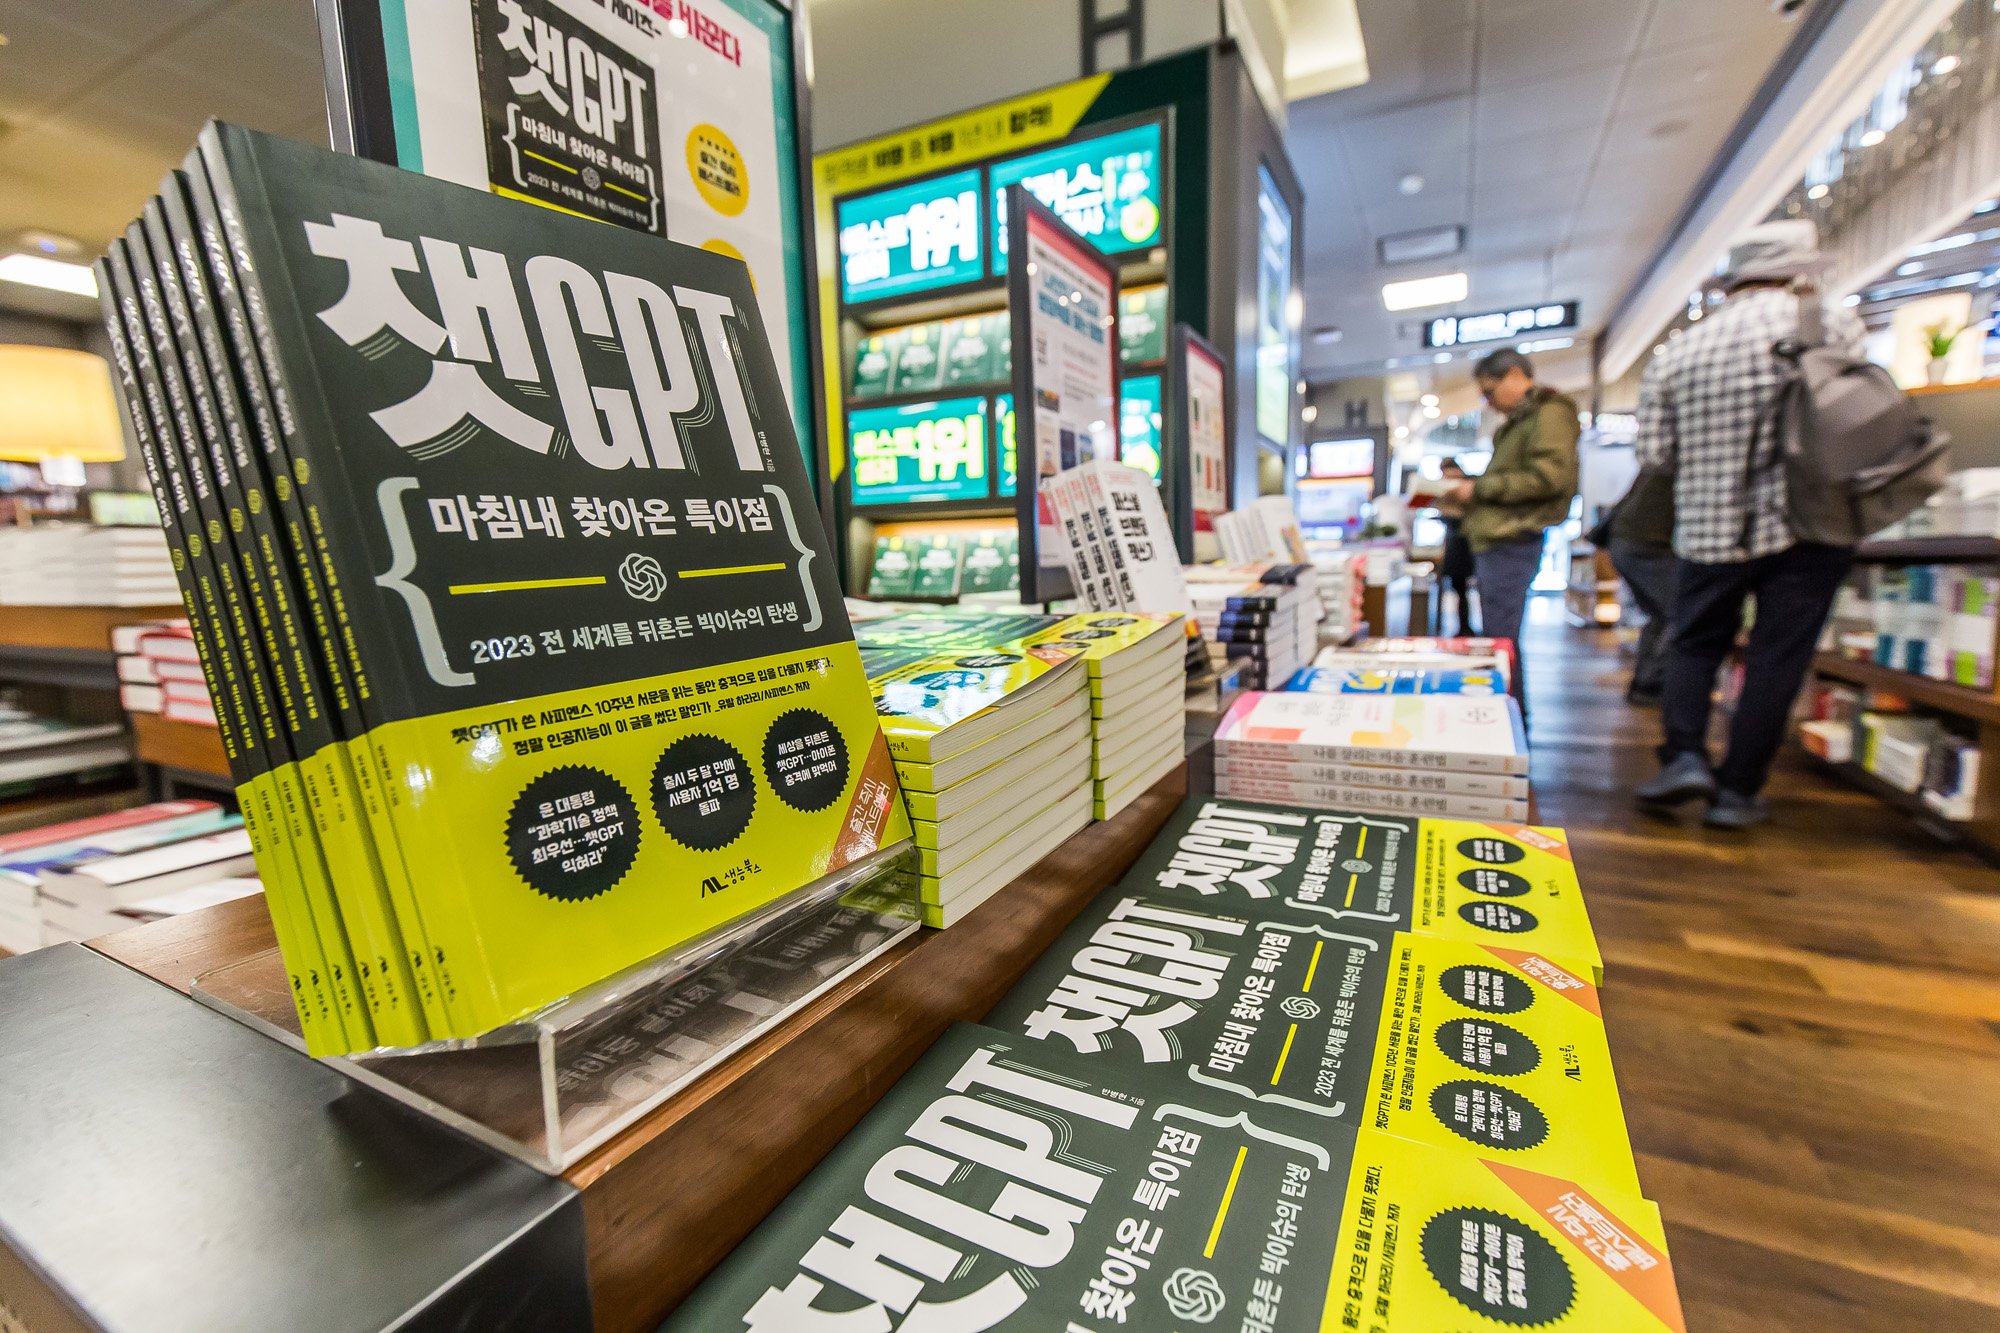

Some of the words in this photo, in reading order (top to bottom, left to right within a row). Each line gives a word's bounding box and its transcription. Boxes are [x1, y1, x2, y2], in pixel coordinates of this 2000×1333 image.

[497, 0, 648, 160] 챗GPT
[522, 115, 566, 151] 마침내
[569, 136, 608, 168] 찾아온
[611, 155, 645, 184] 특이점
[302, 213, 765, 472] 챗GPT
[914, 414, 985, 482] 1위
[428, 495, 565, 540] 마침내
[572, 497, 677, 537] 찾아온
[685, 496, 774, 534] 특이점
[470, 635, 536, 664] 2023
[541, 629, 567, 655] 전
[572, 622, 633, 651] 세계를
[638, 615, 694, 642] 뒤흔든
[697, 605, 765, 634] 빅이슈의
[766, 601, 799, 625] 탄생
[451, 718, 518, 744] 챗GPT가
[521, 714, 536, 730] 쓴
[540, 704, 594, 726] 사피엔스
[594, 695, 634, 715] 10주년
[634, 688, 670, 707] 서문을
[671, 684, 694, 700] 읽는
[695, 680, 717, 694] 동안
[717, 672, 757, 690] 충격으로
[757, 667, 776, 682] 입을
[777, 662, 804, 677] 다물지
[513, 737, 544, 756] 정말
[547, 722, 612, 749] 인공지능이
[615, 718, 628, 734] 이
[630, 714, 653, 729] 글을
[654, 708, 677, 725] 썼단
[678, 701, 711, 719] 말인가
[735, 683, 795, 706] 하라리/사피엔스
[794, 680, 811, 692] 저자
[777, 738, 805, 756] 세상을
[804, 730, 830, 747] 뒤흔든
[662, 771, 686, 791] 출시
[687, 768, 699, 782] 두
[699, 764, 712, 779] 달
[712, 758, 736, 775] 만에
[669, 785, 702, 807] 사용자
[702, 777, 725, 798] 1억
[724, 773, 740, 791] 명
[784, 768, 812, 787] 충격에
[811, 760, 837, 778] 맞먹어
[539, 801, 555, 819] 윤
[555, 790, 596, 813] 대통령
[591, 804, 619, 823] 정책
[698, 797, 721, 817] 돌파
[850, 803, 865, 834] 출간
[858, 777, 878, 806] 즉시
[1156, 802, 1307, 898] 챗GPT
[1314, 821, 1343, 848] 특이점
[724, 858, 762, 884] 생능북스
[1305, 848, 1336, 875] 찾아온
[1297, 873, 1329, 902] 마침내
[1251, 932, 1292, 973] 특이점
[1347, 947, 1366, 965] 탄생
[1023, 898, 1248, 1063] 챗GPT
[1339, 964, 1363, 998] 빅이슈의
[1230, 975, 1275, 1021] 찾아온
[1332, 999, 1355, 1027] 뒤흔든
[1208, 1021, 1257, 1073] 마침내
[1325, 1028, 1349, 1057] 세계를
[1321, 1057, 1341, 1069] 전
[1101, 1088, 1128, 1101] 반병현
[1129, 1096, 1146, 1107] 지음
[1314, 1069, 1337, 1098] 2023
[742, 1047, 1140, 1333] 챗GPT
[1281, 1162, 1311, 1198] 탄생
[1364, 1165, 1383, 1196] 못했다.
[1080, 1217, 1164, 1324] 찾아온
[1132, 1125, 1202, 1211] 특이점
[1359, 1196, 1376, 1229] 다물지
[1387, 1203, 1400, 1223] 저자
[1546, 1204, 1588, 1238] 즉시
[1259, 1199, 1303, 1275] 빅이슈의
[1355, 1229, 1372, 1252] 입을
[1347, 1253, 1367, 1300] 충격으로
[1240, 1277, 1283, 1333] 뒤흔든
